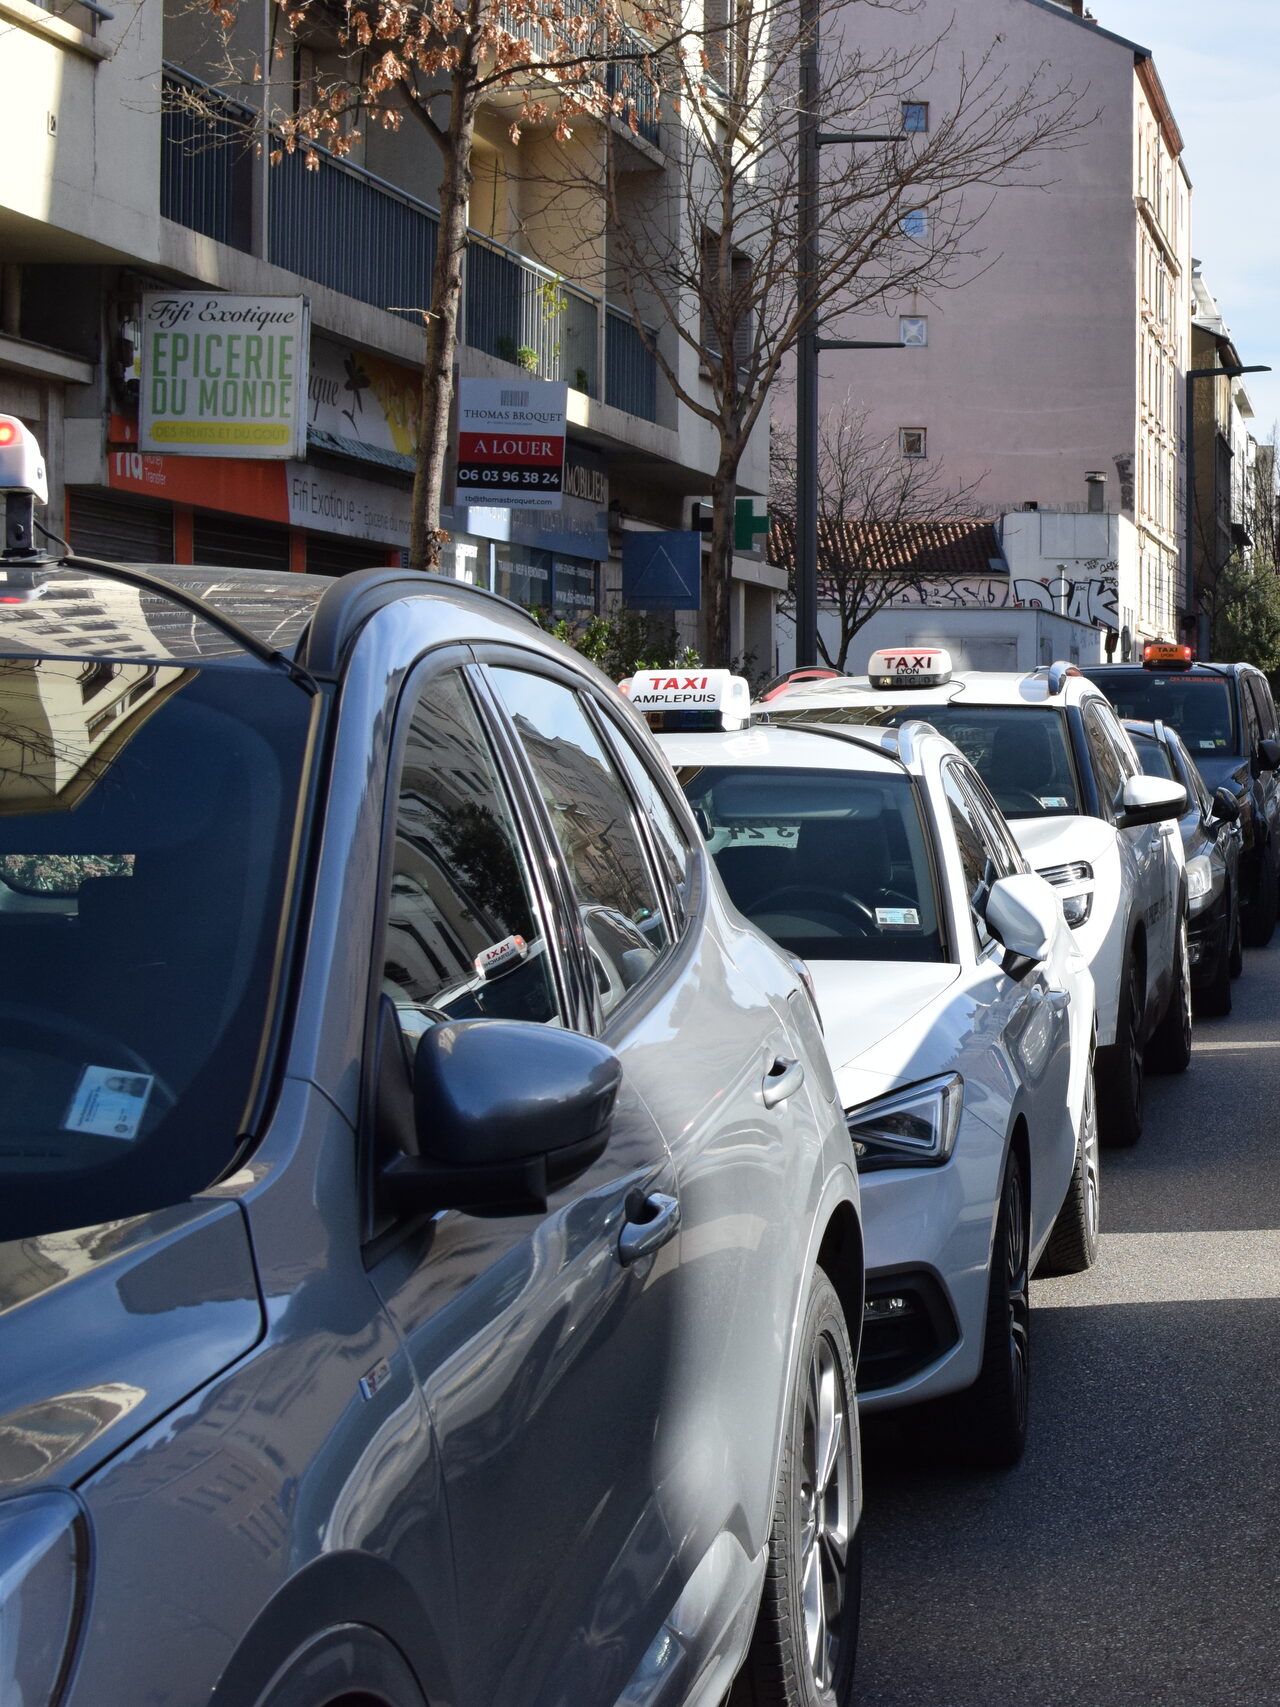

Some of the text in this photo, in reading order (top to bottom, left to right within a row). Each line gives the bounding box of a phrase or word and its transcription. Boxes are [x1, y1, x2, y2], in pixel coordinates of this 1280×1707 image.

[148, 299, 295, 331] Fifi Exotique
[151, 332, 294, 380] EPICERIE
[151, 377, 292, 419] DU MONDE
[463, 409, 510, 419] THOMAS
[513, 411, 563, 423] BROQUET
[157, 426, 177, 438] DES
[180, 426, 215, 439] FRUITS
[218, 427, 230, 439] ET
[233, 427, 250, 439] DU
[474, 439, 554, 456] A LOUER
[115, 452, 143, 481] ria
[459, 469, 559, 484] 06 03 96 38 24
[292, 478, 308, 510] Fifi
[311, 483, 355, 526] Exotique
[464, 495, 553, 506] tb@thomasbroquet.com
[884, 656, 932, 669] TAXI
[649, 677, 708, 691] TAXI
[632, 693, 717, 704] AMPLEPUIS
